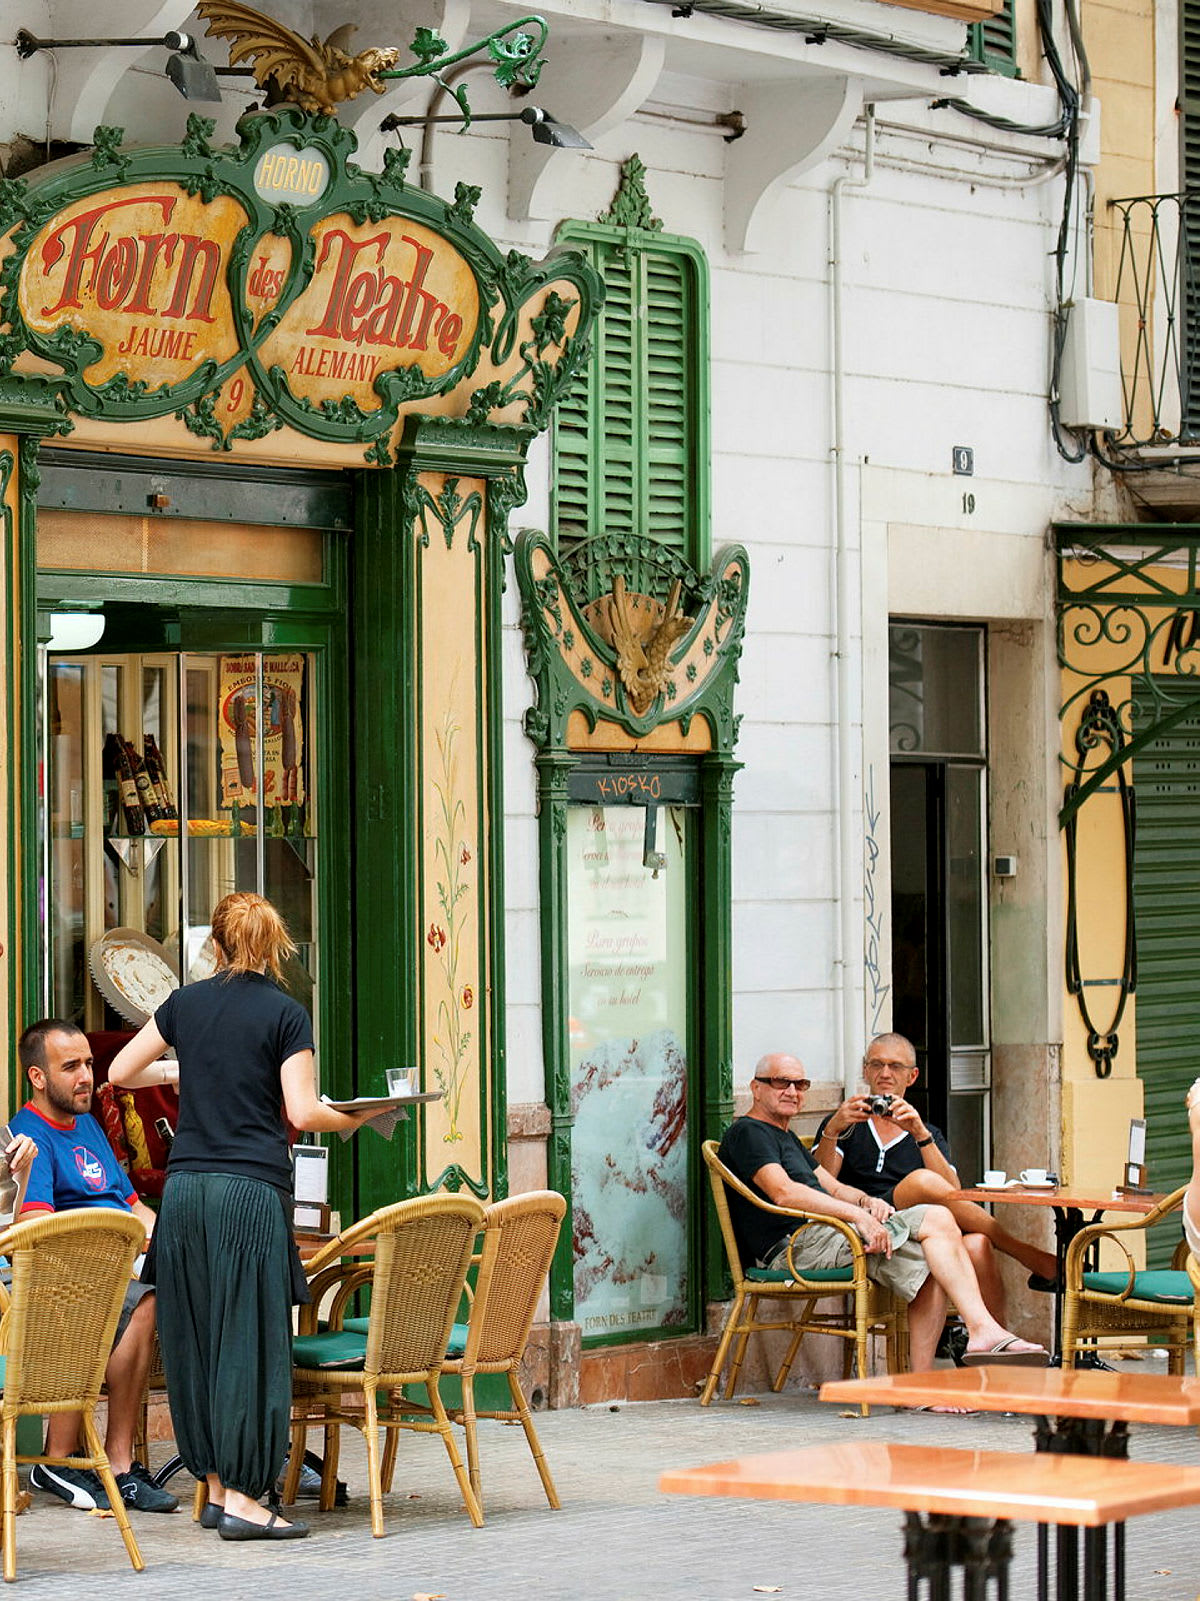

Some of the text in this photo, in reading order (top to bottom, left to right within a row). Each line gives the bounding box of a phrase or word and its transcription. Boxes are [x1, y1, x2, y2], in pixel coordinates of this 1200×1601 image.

[257, 151, 325, 195] HORNO
[41, 196, 463, 360] Forn des Teatre
[118, 325, 382, 383] JAUME ALEMANY
[227, 379, 244, 412] 9
[960, 450, 968, 470] 9
[962, 492, 975, 514] 19
[598, 775, 661, 799] KIOSKO
[619, 988, 641, 1006] hotel
[584, 1309, 657, 1330] FORN DES TEATRE
